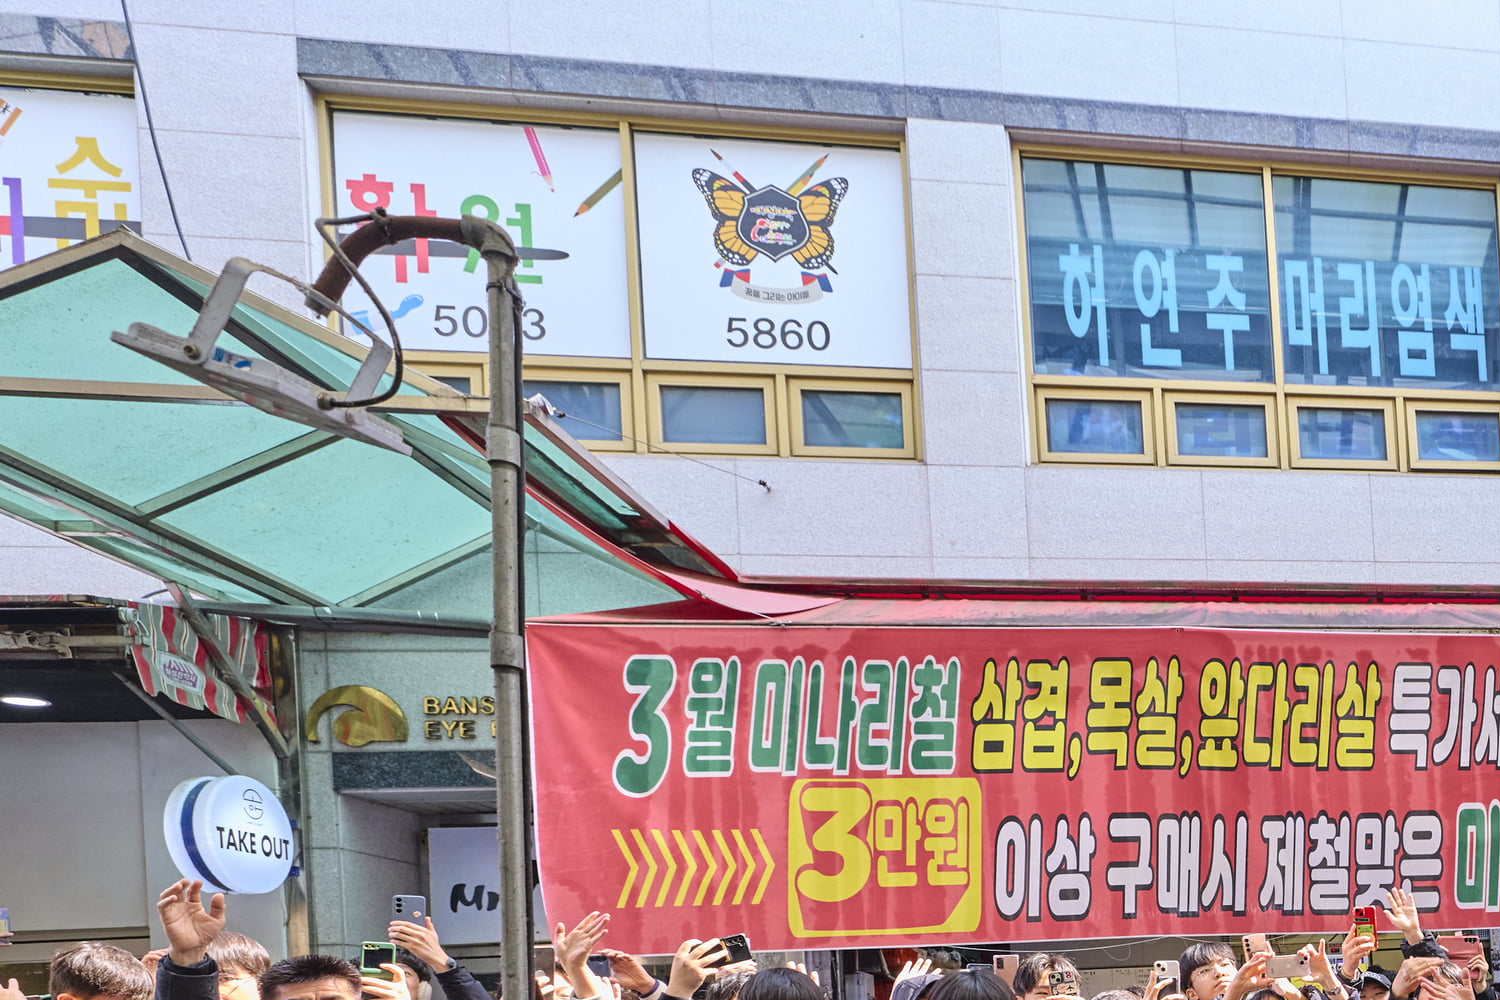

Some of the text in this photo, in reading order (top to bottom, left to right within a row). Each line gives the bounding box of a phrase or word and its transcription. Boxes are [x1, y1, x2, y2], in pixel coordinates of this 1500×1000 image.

[346, 173, 543, 284] 학원
[762, 290, 785, 302] 그리는
[1059, 243, 1488, 382] 허연주 머리염색
[433, 303, 547, 341] 503
[726, 316, 831, 352] 5860
[423, 720, 476, 739] EYE
[611, 654, 741, 799] 3월
[748, 654, 960, 778] 미나리철
[216, 825, 290, 861] TAKE OUT
[794, 784, 972, 904] 3만원
[994, 813, 1096, 923] 이상
[1107, 810, 1248, 920] 구매시
[1258, 809, 1443, 915] 제철맞은
